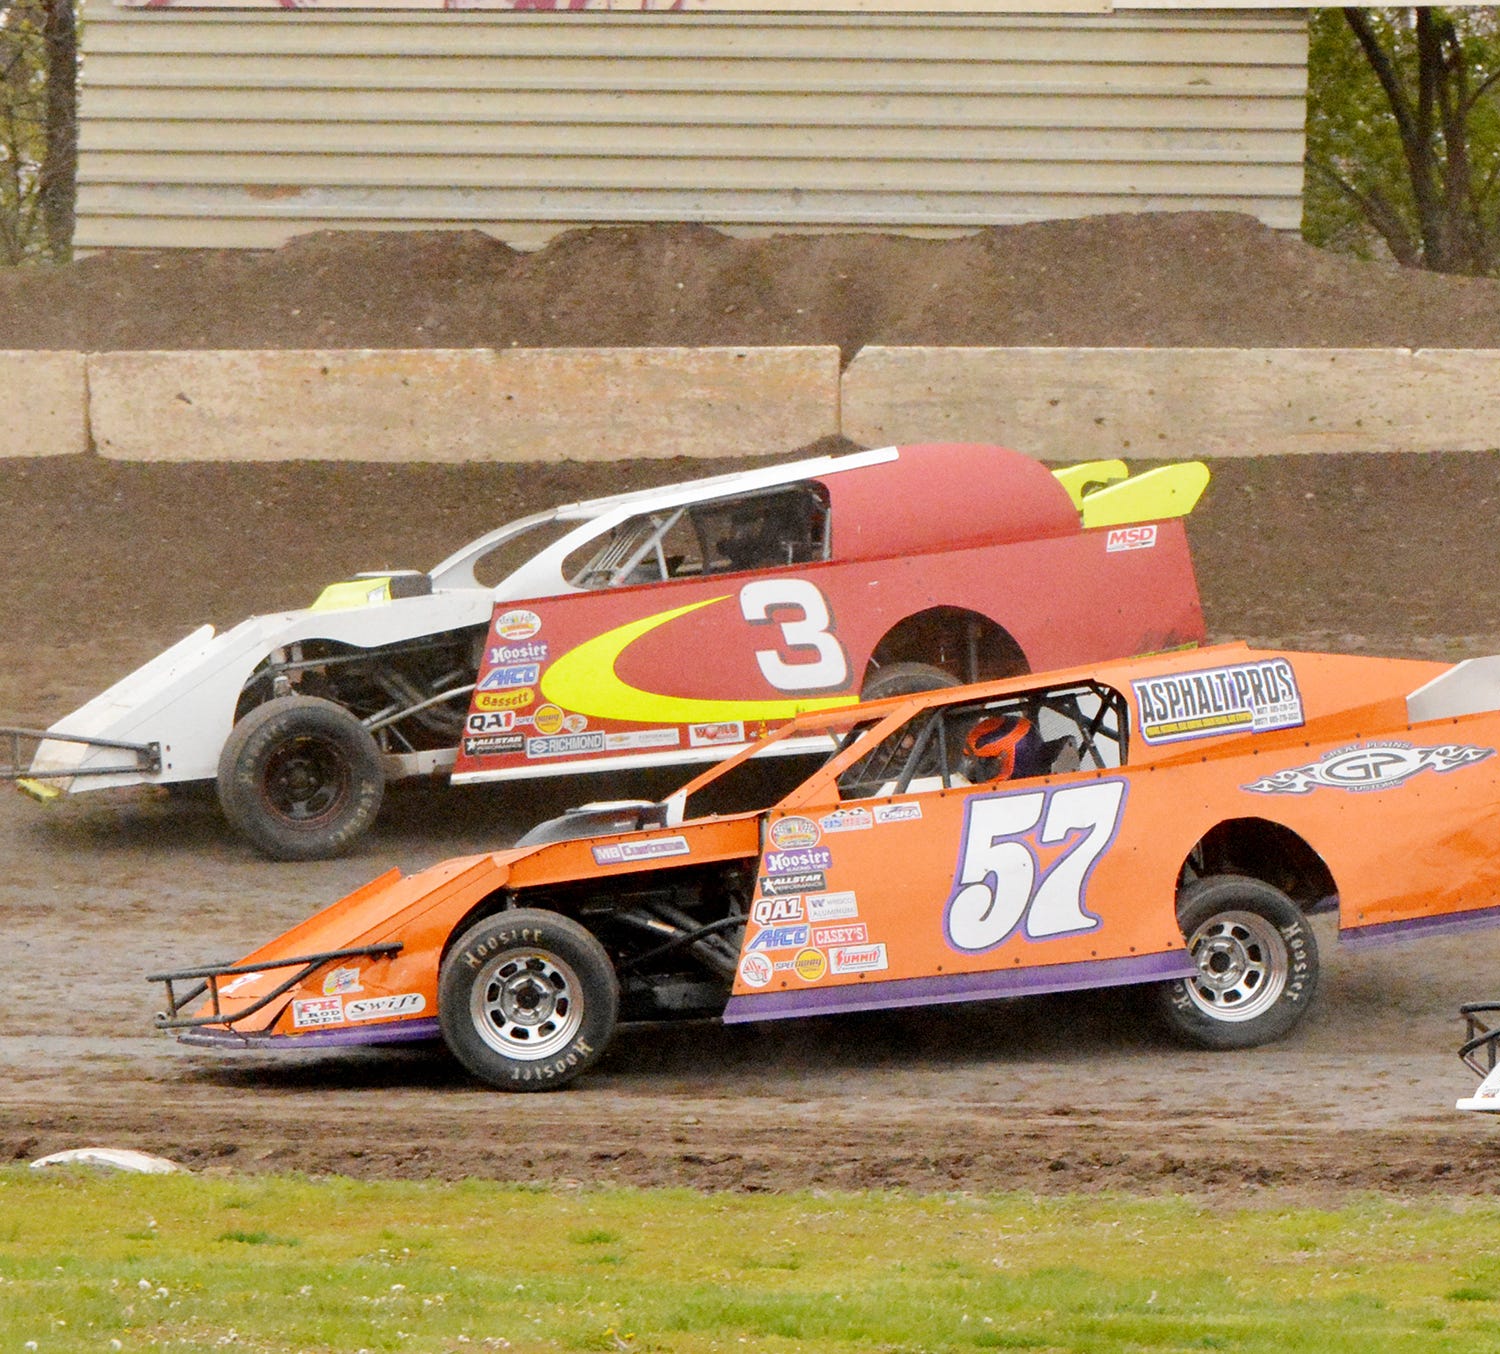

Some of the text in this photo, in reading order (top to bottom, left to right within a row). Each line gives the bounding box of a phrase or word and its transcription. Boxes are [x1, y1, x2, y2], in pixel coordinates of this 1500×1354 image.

[1109, 527, 1154, 546] MSD
[740, 578, 851, 692] 3
[490, 643, 548, 664] Hoosier
[481, 664, 537, 689] AFCO
[482, 691, 529, 707] Bassett
[1137, 663, 1294, 724] ASPHALT PROS
[469, 712, 513, 732] QA1
[475, 736, 522, 746] ALLSTAR
[549, 732, 602, 753] RICHMOND
[1365, 741, 1412, 750] PLAINS
[767, 849, 830, 872] Hoosier
[947, 779, 1128, 951] 57
[773, 874, 822, 885] ALLSTAR
[755, 897, 803, 925] QA1
[748, 925, 809, 951] AFCO
[815, 927, 865, 944] CASEY'S
[463, 927, 543, 969] Hoosier
[1281, 920, 1310, 1001] Hoosier
[302, 999, 339, 1013] FK
[308, 1010, 341, 1018] ROD
[351, 994, 420, 1013] Swift
[299, 1017, 342, 1026] ENDS
[511, 1036, 594, 1081] Hoosier
